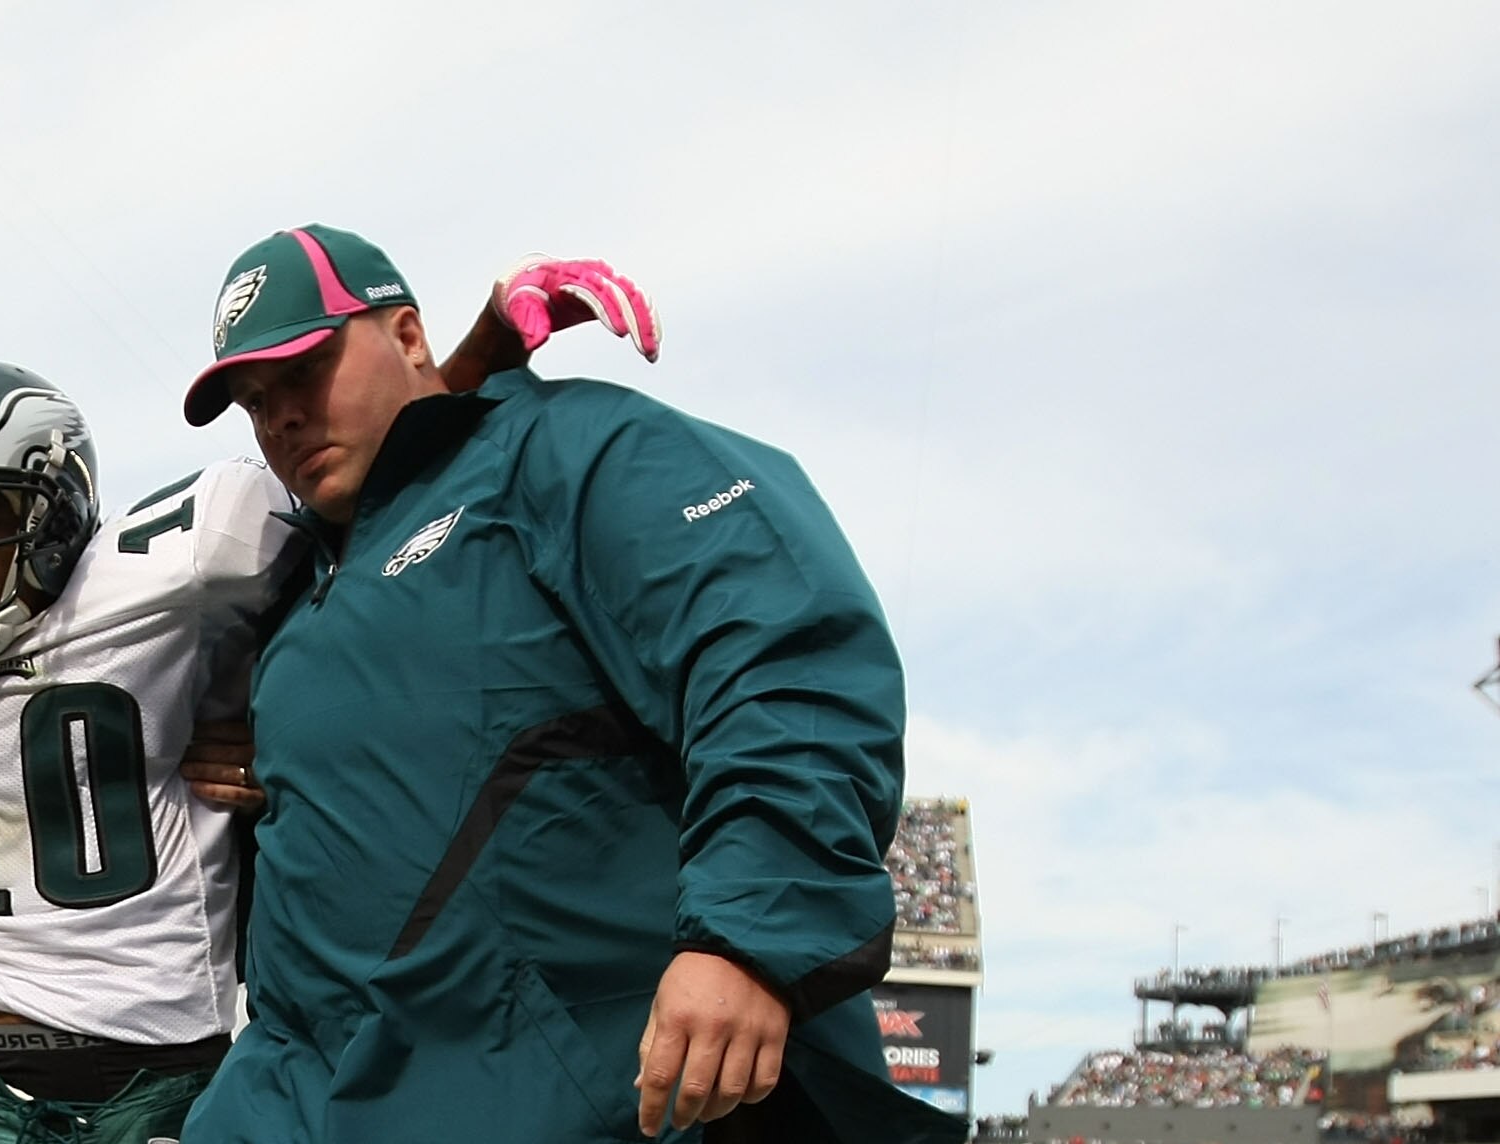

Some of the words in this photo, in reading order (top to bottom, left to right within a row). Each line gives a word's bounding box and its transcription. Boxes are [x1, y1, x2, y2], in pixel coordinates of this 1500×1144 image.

[365, 282, 405, 300] Reebok
[682, 479, 756, 522] Reebok
[884, 1046, 941, 1069] ORIES
